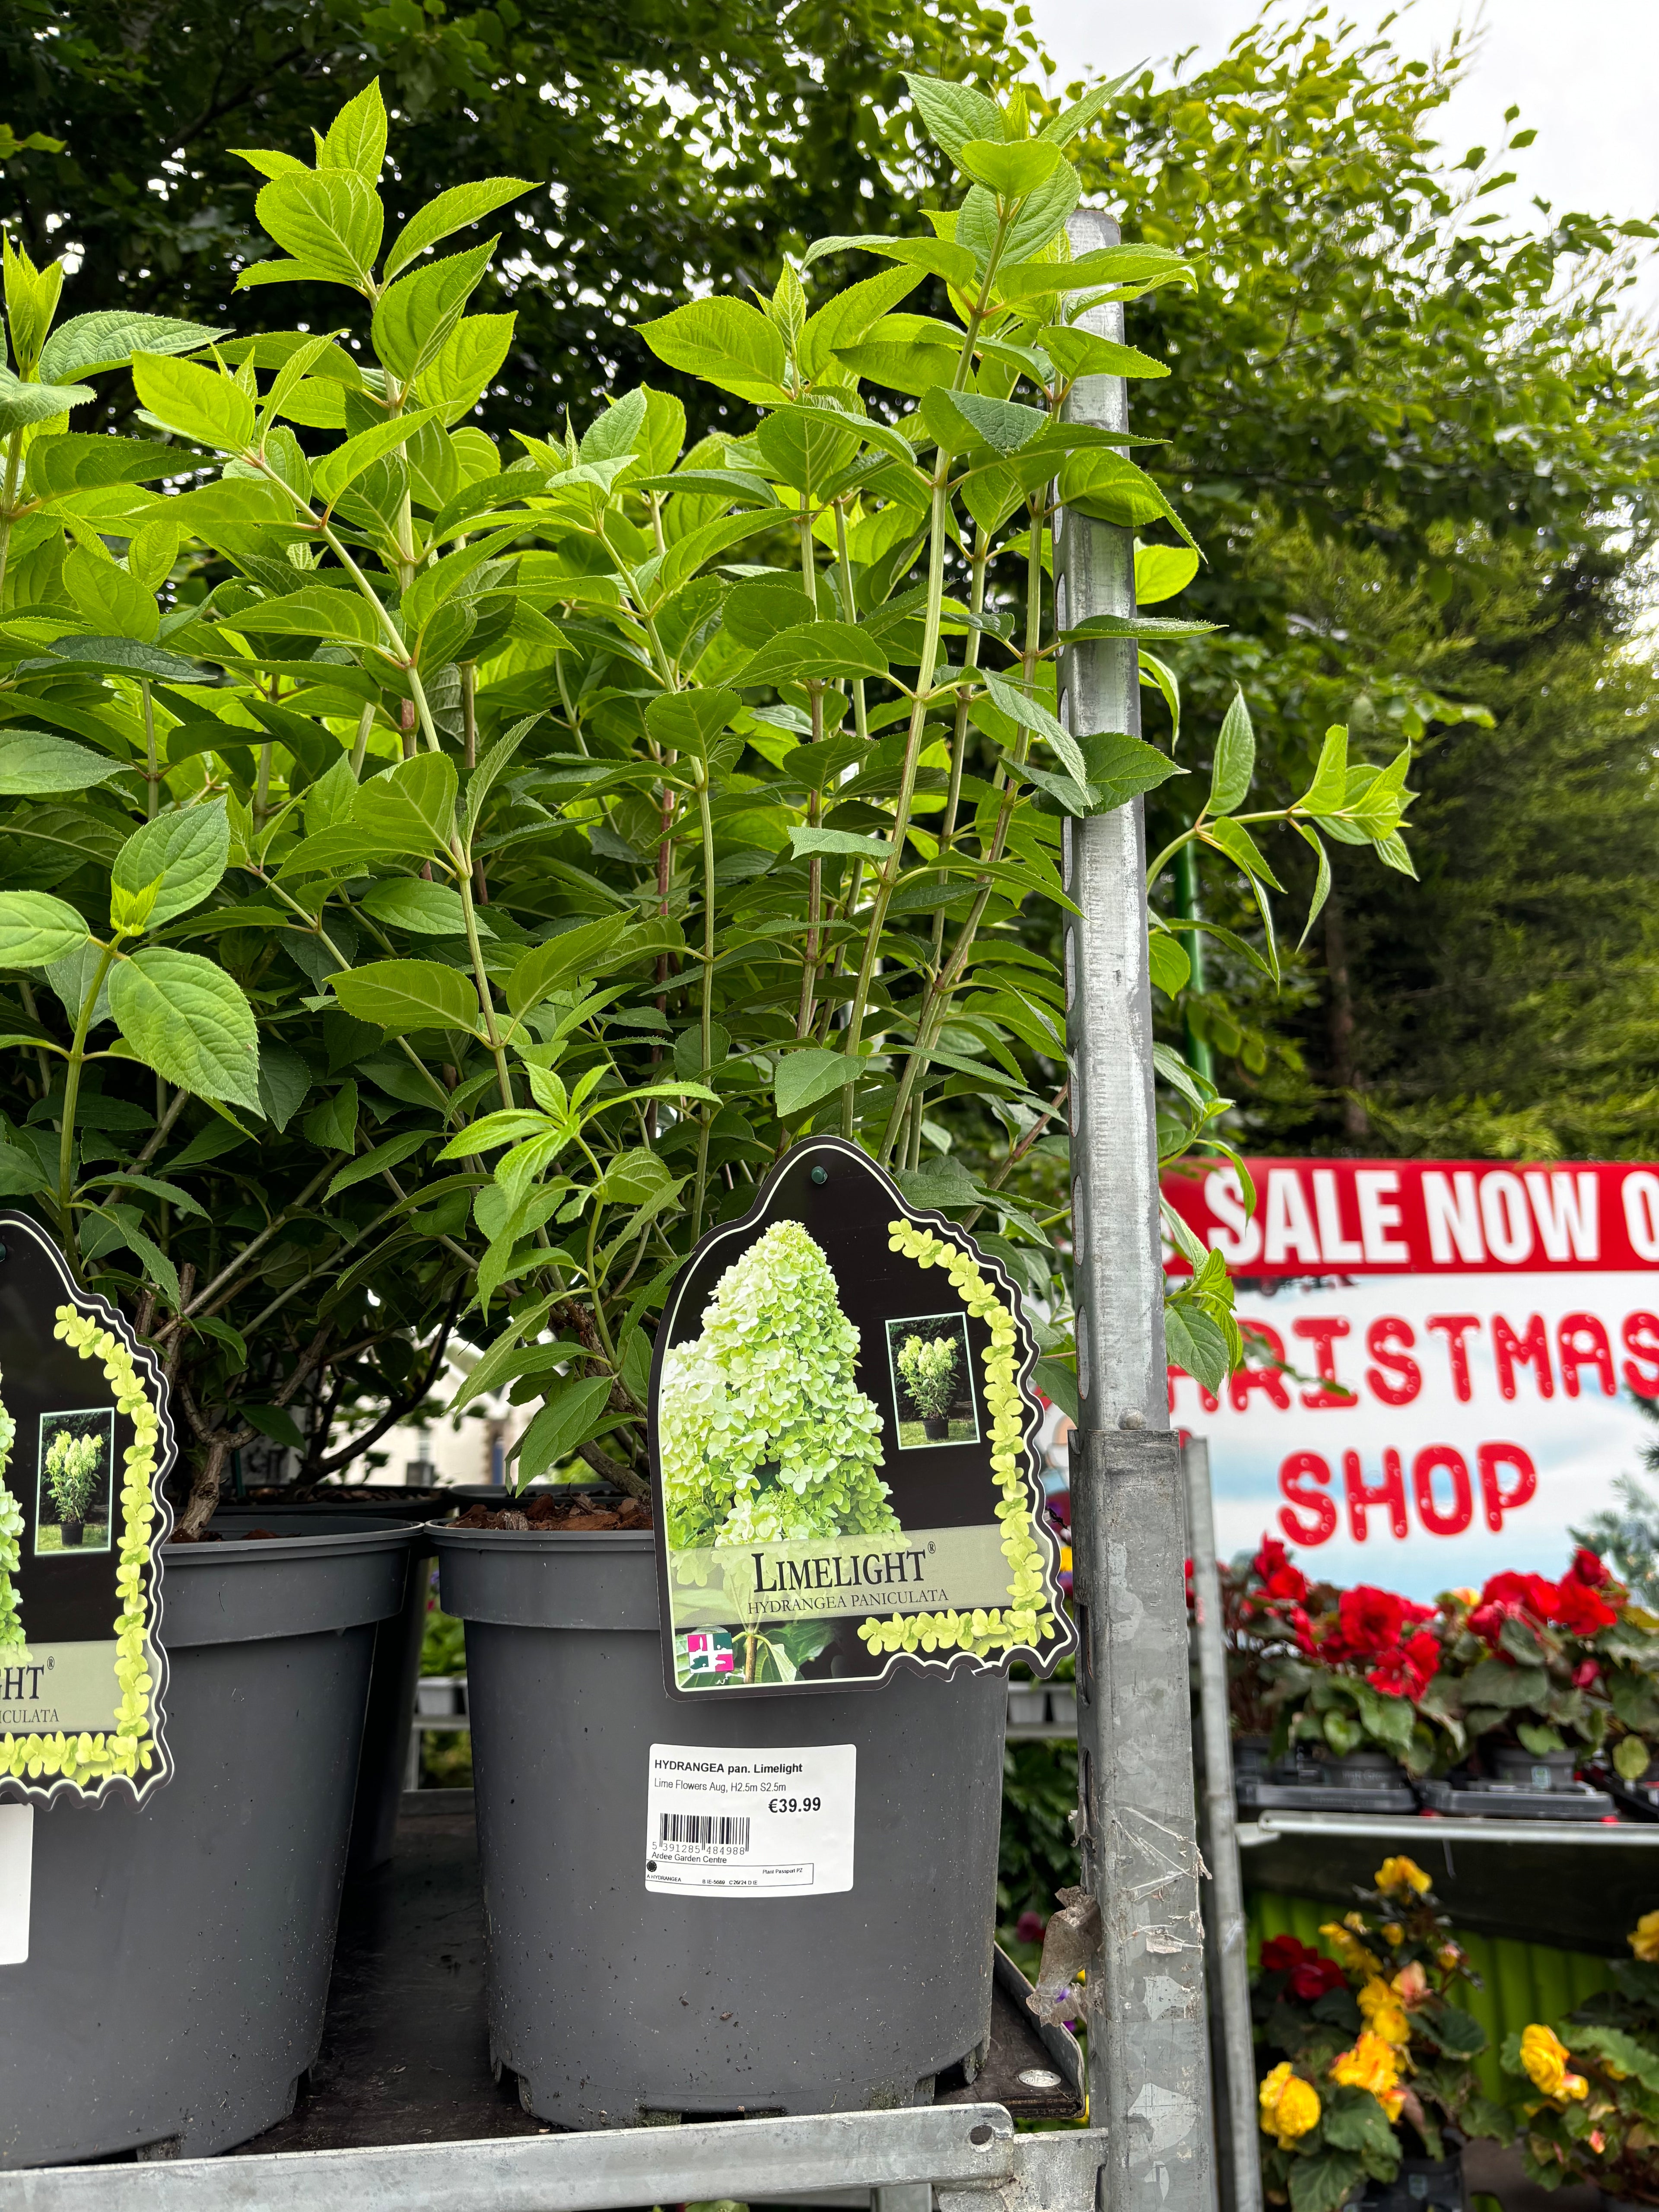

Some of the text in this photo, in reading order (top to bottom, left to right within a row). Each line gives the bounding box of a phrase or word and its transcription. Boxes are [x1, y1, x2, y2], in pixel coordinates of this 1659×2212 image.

[1204, 1168, 1411, 1265] SALE
[1421, 1170, 1601, 1264] NOW
[1277, 1441, 1538, 1548] SHOP
[748, 1589, 949, 1615] HYDRANGEA PANICULATA
[655, 1760, 803, 1775] HYDRANGEA pan. Limelight
[655, 1778, 786, 1793] Lime Flowers Aug, H2.5m S2.5m
[768, 1796, 821, 1813] €39.99
[652, 1852, 673, 1860] Ardee
[674, 1854, 701, 1862] Garden
